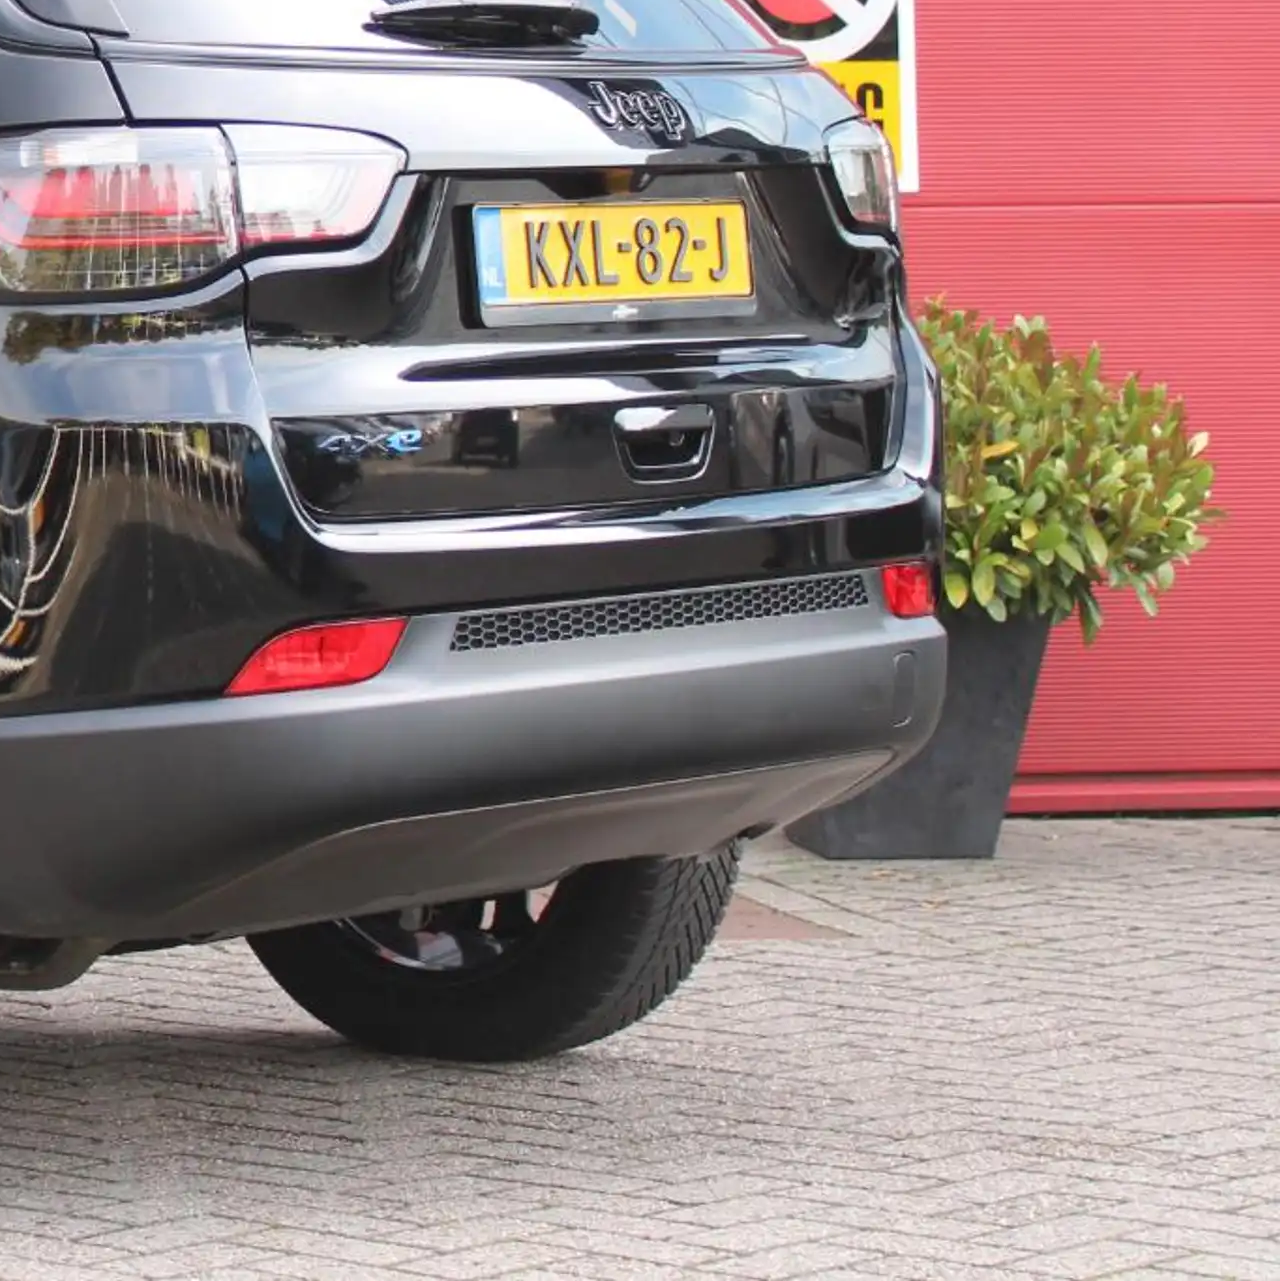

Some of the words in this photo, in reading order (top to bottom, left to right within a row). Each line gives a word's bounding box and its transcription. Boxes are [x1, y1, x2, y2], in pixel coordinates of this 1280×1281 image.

[587, 81, 686, 140] Jeep
[482, 267, 503, 288] NL
[524, 216, 730, 289] KXL-82-J
